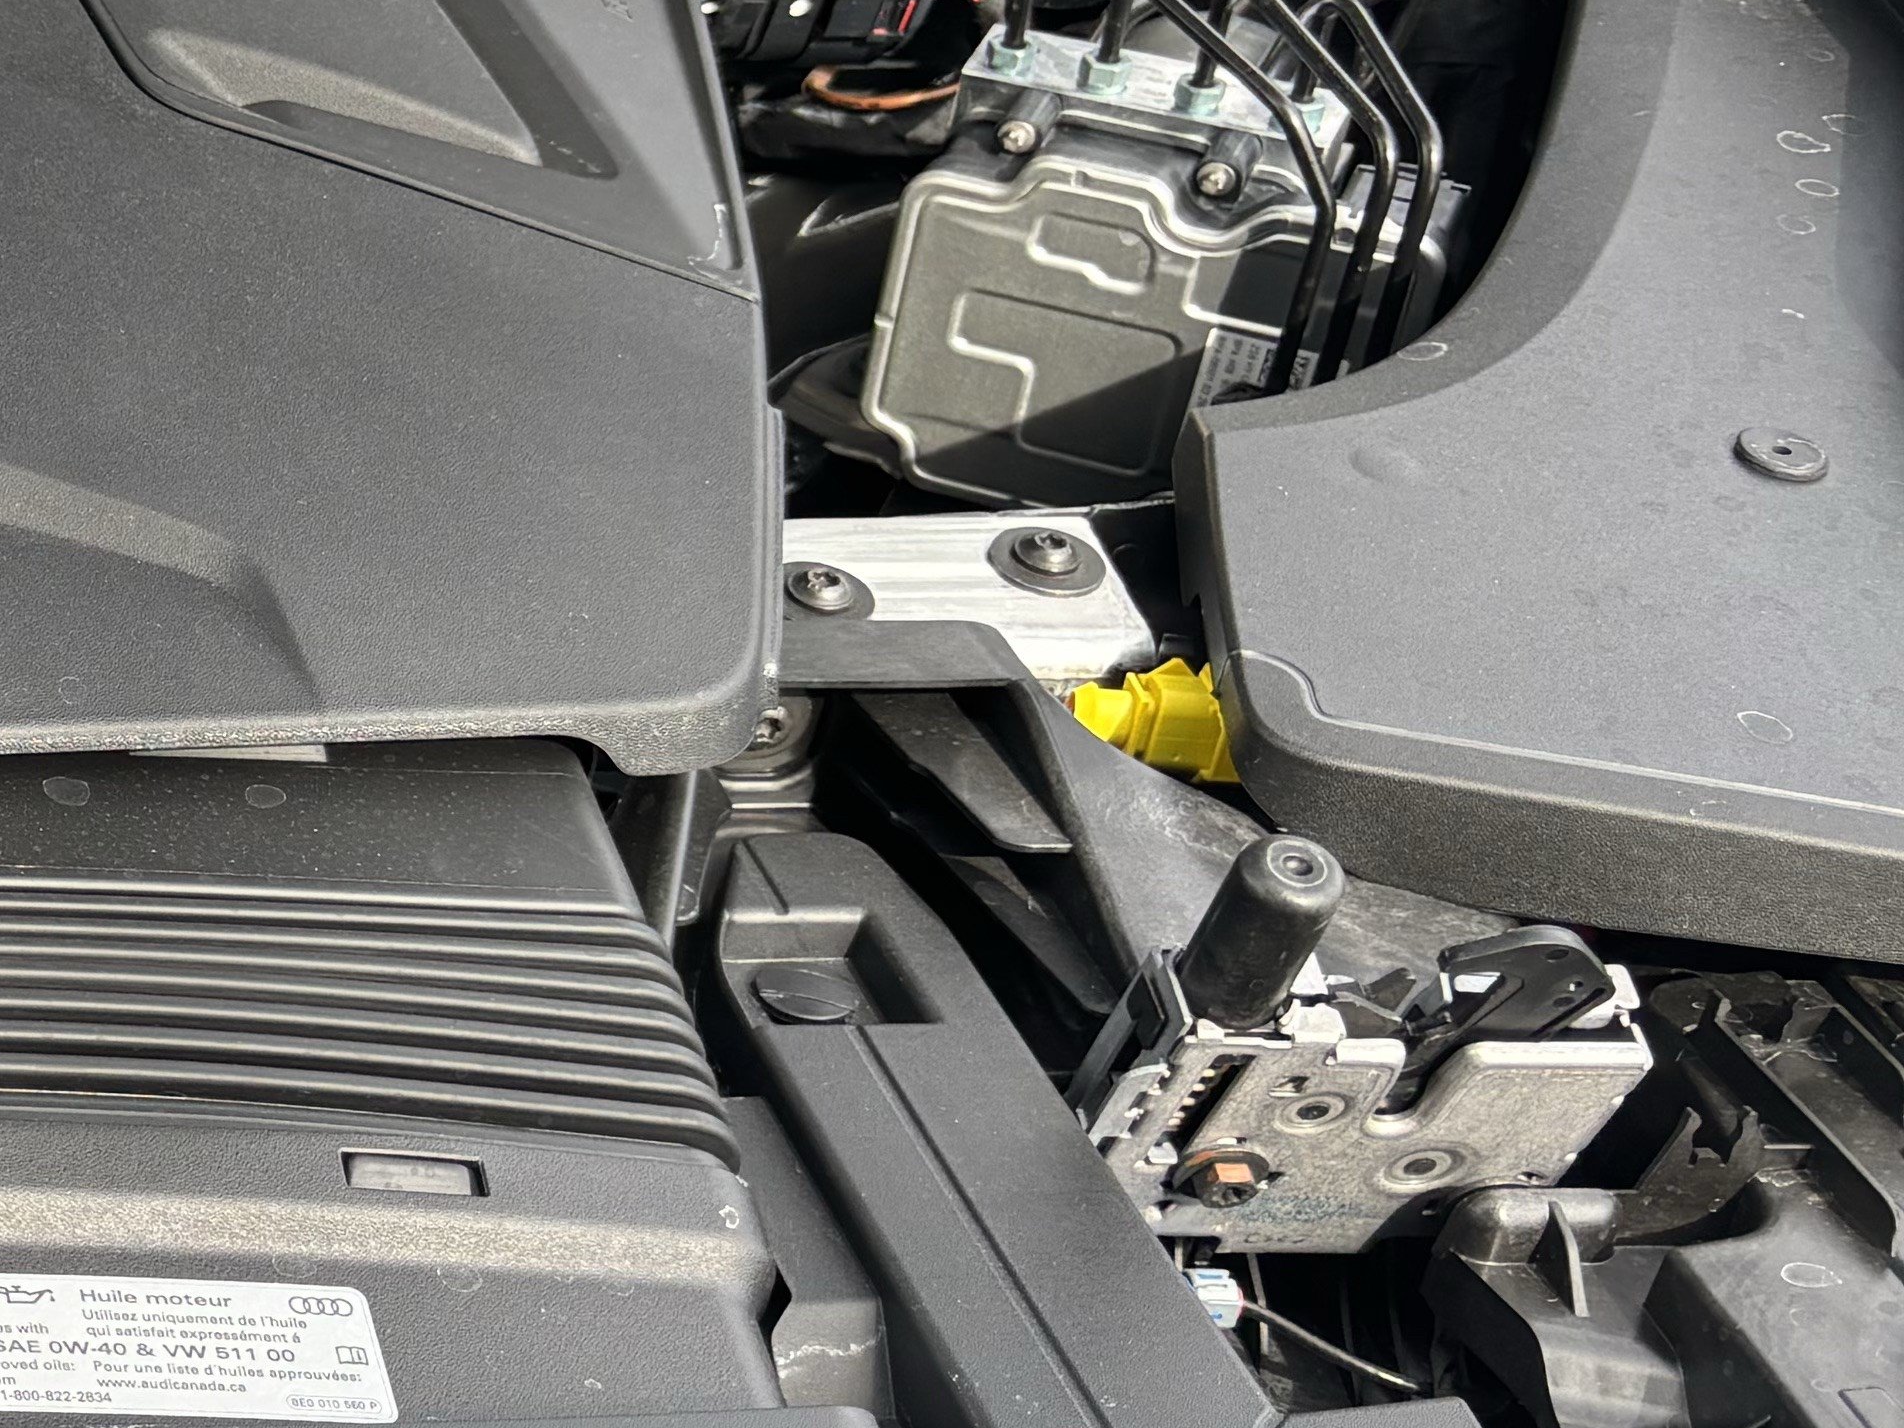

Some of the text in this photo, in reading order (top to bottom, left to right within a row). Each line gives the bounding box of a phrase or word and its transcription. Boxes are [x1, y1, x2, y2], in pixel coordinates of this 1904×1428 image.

[79, 1289, 232, 1308] Huile moteur
[81, 1308, 139, 1322] Utilisez
[142, 1313, 234, 1328] uniquement
[238, 1315, 257, 1327] de
[16, 1323, 50, 1335] with
[86, 1326, 112, 1339] qui
[116, 1326, 176, 1340] satisfait
[49, 1341, 127, 1356] 0W-40
[136, 1344, 155, 1357] &
[163, 1344, 206, 1359] VW
[216, 1347, 258, 1361] 511
[267, 1349, 295, 1363] 00
[43, 1359, 76, 1371] oils:
[93, 1360, 130, 1373] Pour
[133, 1364, 163, 1375] une
[167, 1362, 200, 1375] liste
[96, 1378, 247, 1393] www.audicanada.ca
